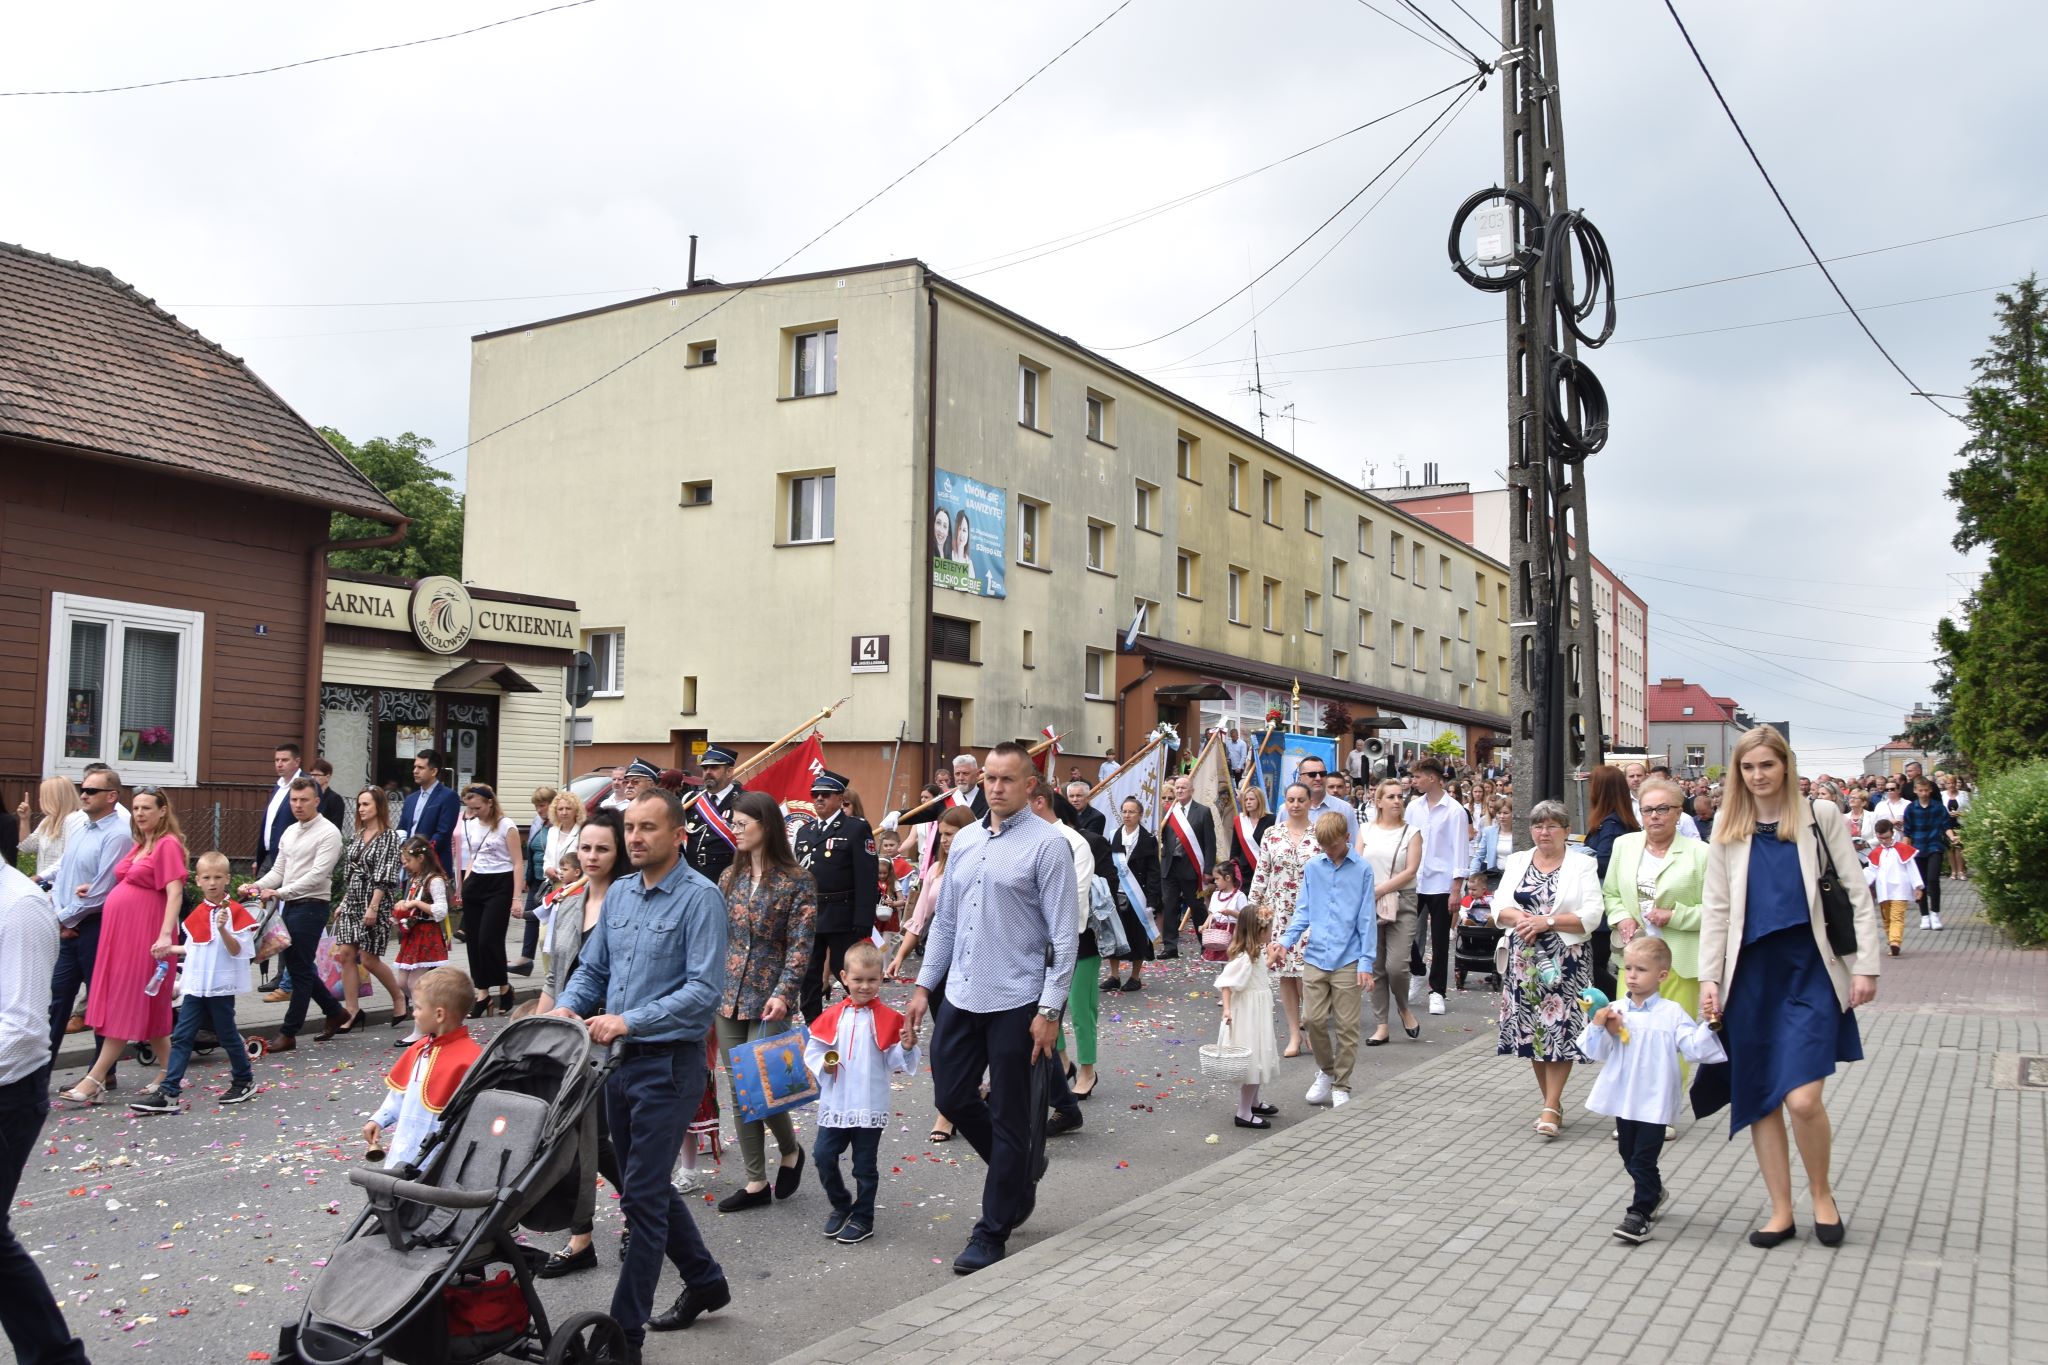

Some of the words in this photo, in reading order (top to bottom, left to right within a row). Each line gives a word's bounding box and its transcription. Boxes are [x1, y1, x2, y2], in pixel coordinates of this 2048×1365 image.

[934, 559, 969, 574] DIETETYK
[478, 610, 574, 639] CUKIERNIA
[863, 639, 877, 658] 4
